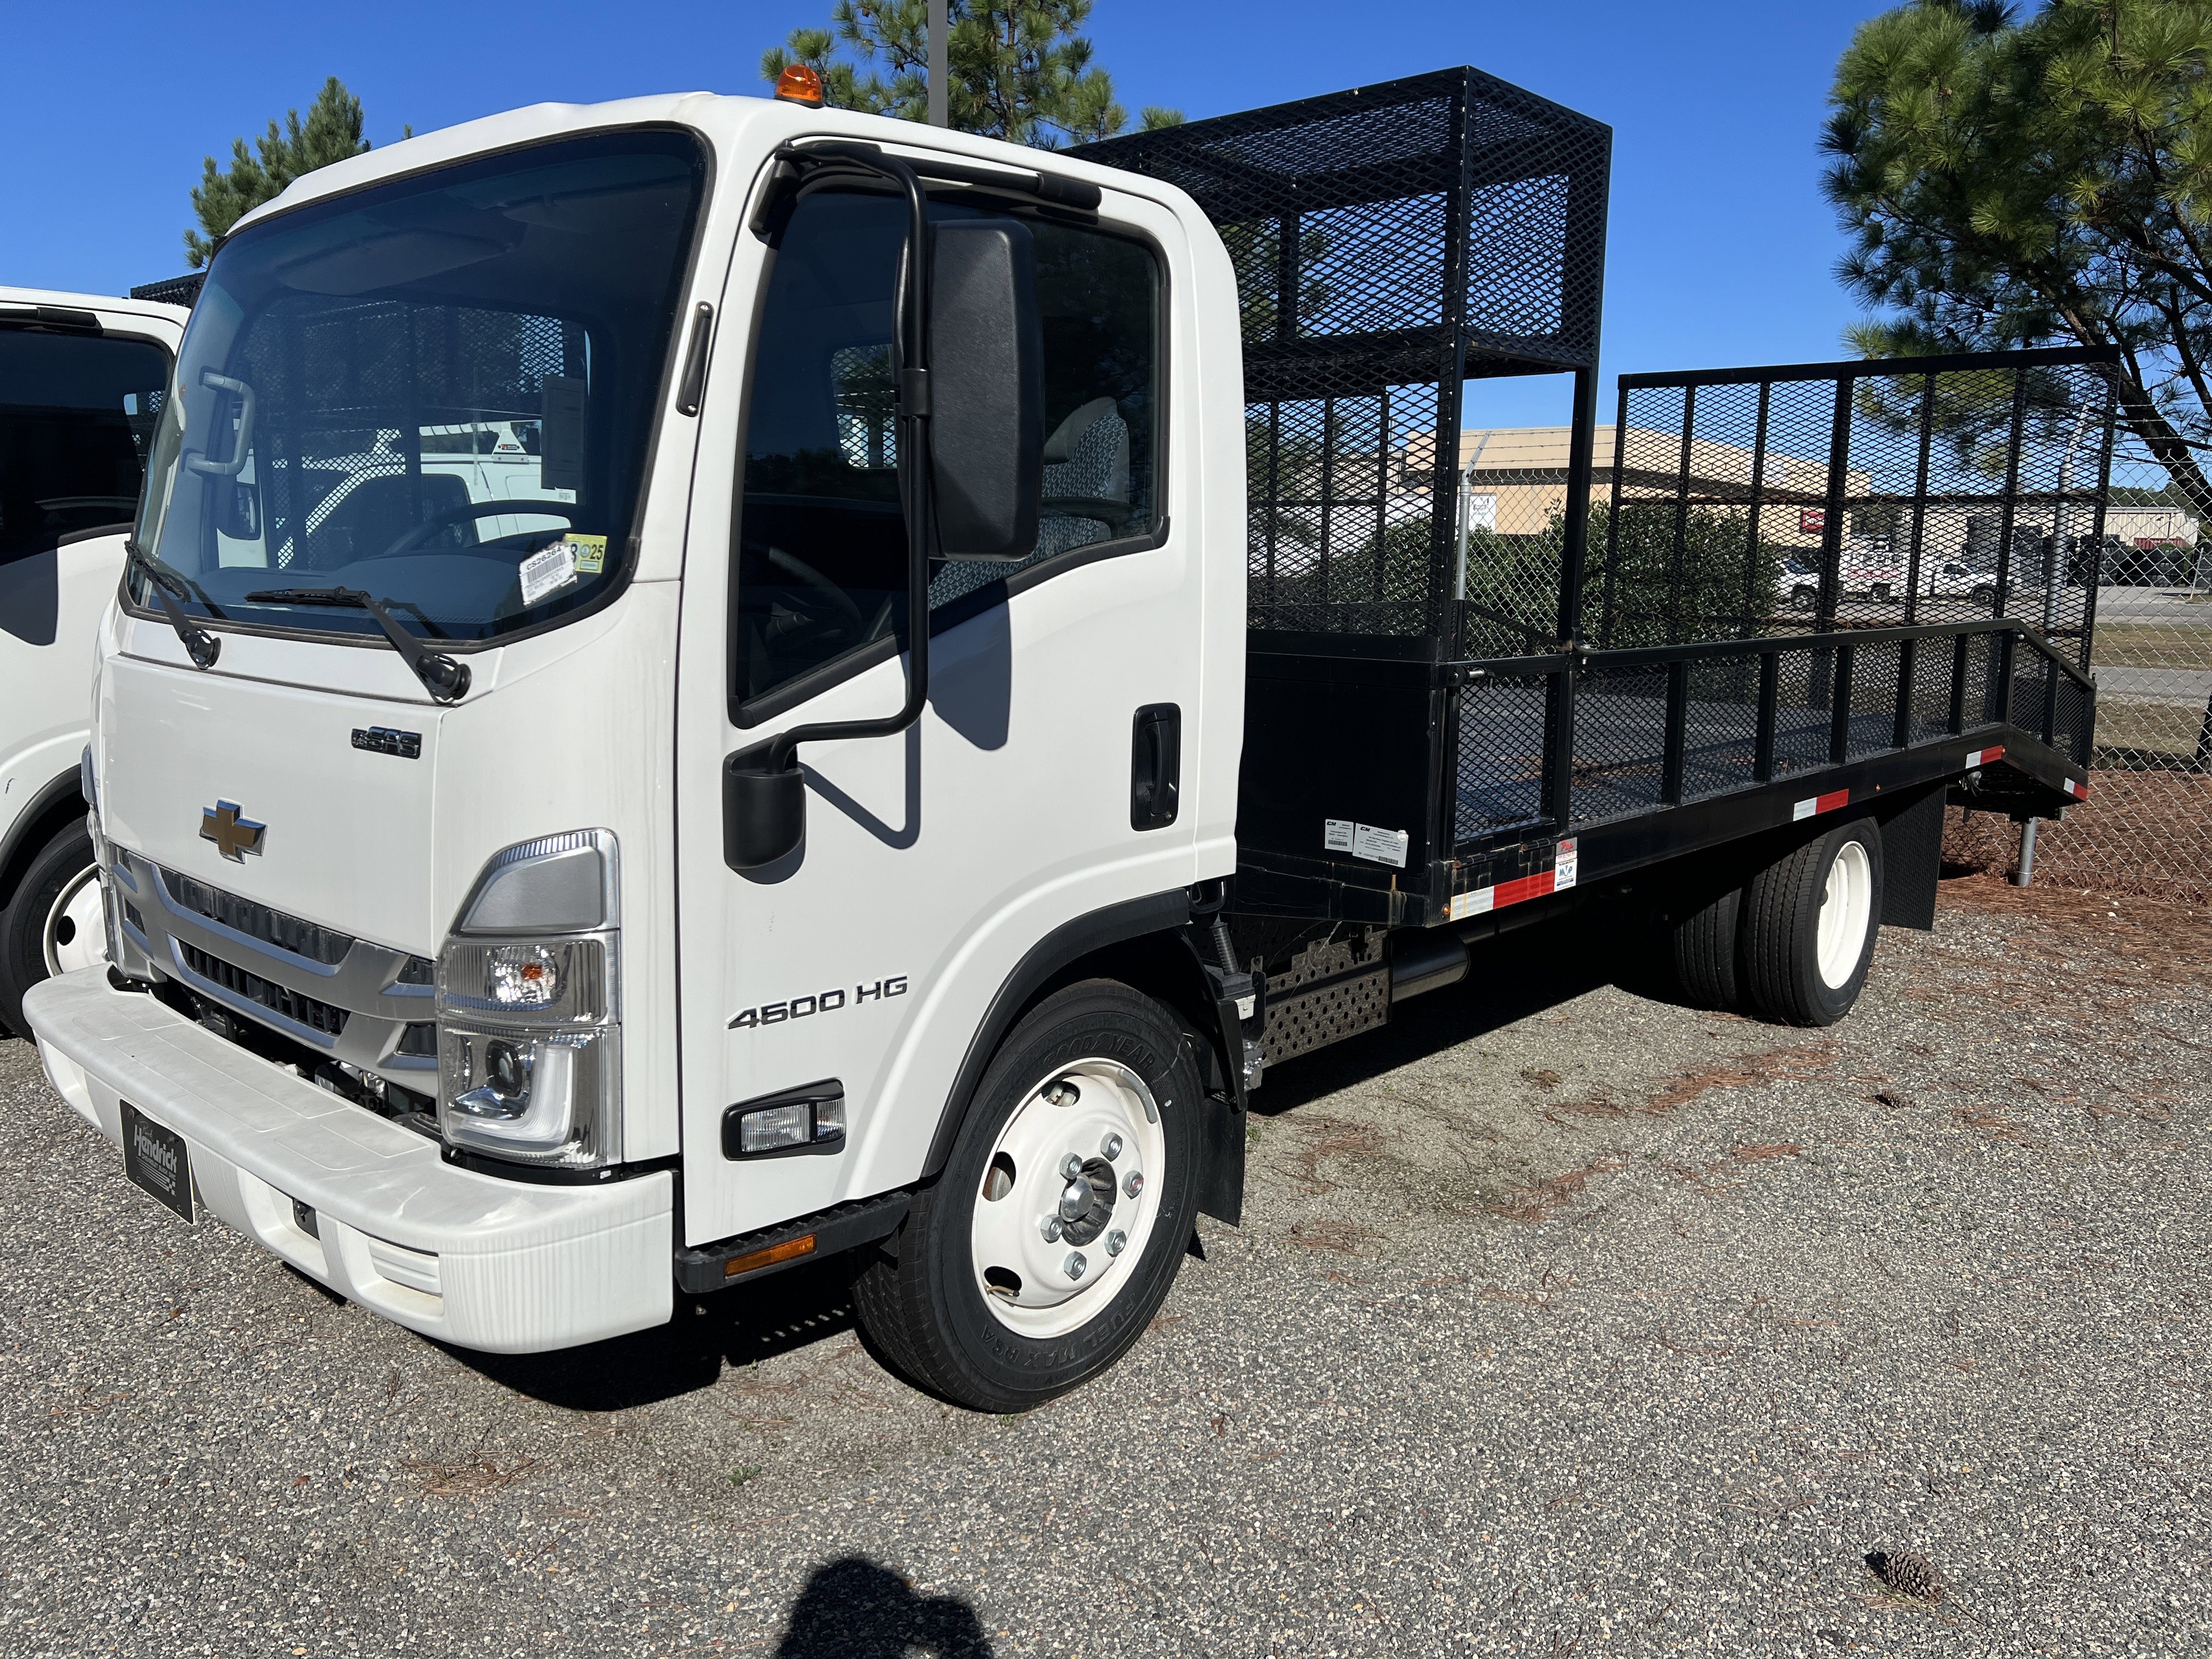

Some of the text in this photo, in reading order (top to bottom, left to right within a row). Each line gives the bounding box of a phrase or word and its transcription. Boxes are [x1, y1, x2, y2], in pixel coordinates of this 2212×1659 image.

[527, 546, 562, 570] CS26264
[590, 544, 603, 560] 25
[727, 975, 908, 1030] 4500 HG
[1043, 1031, 1155, 1070] GOODYEAR
[133, 1124, 177, 1173] Hendrick
[980, 1293, 1137, 1367] FUEL MAX RSA
